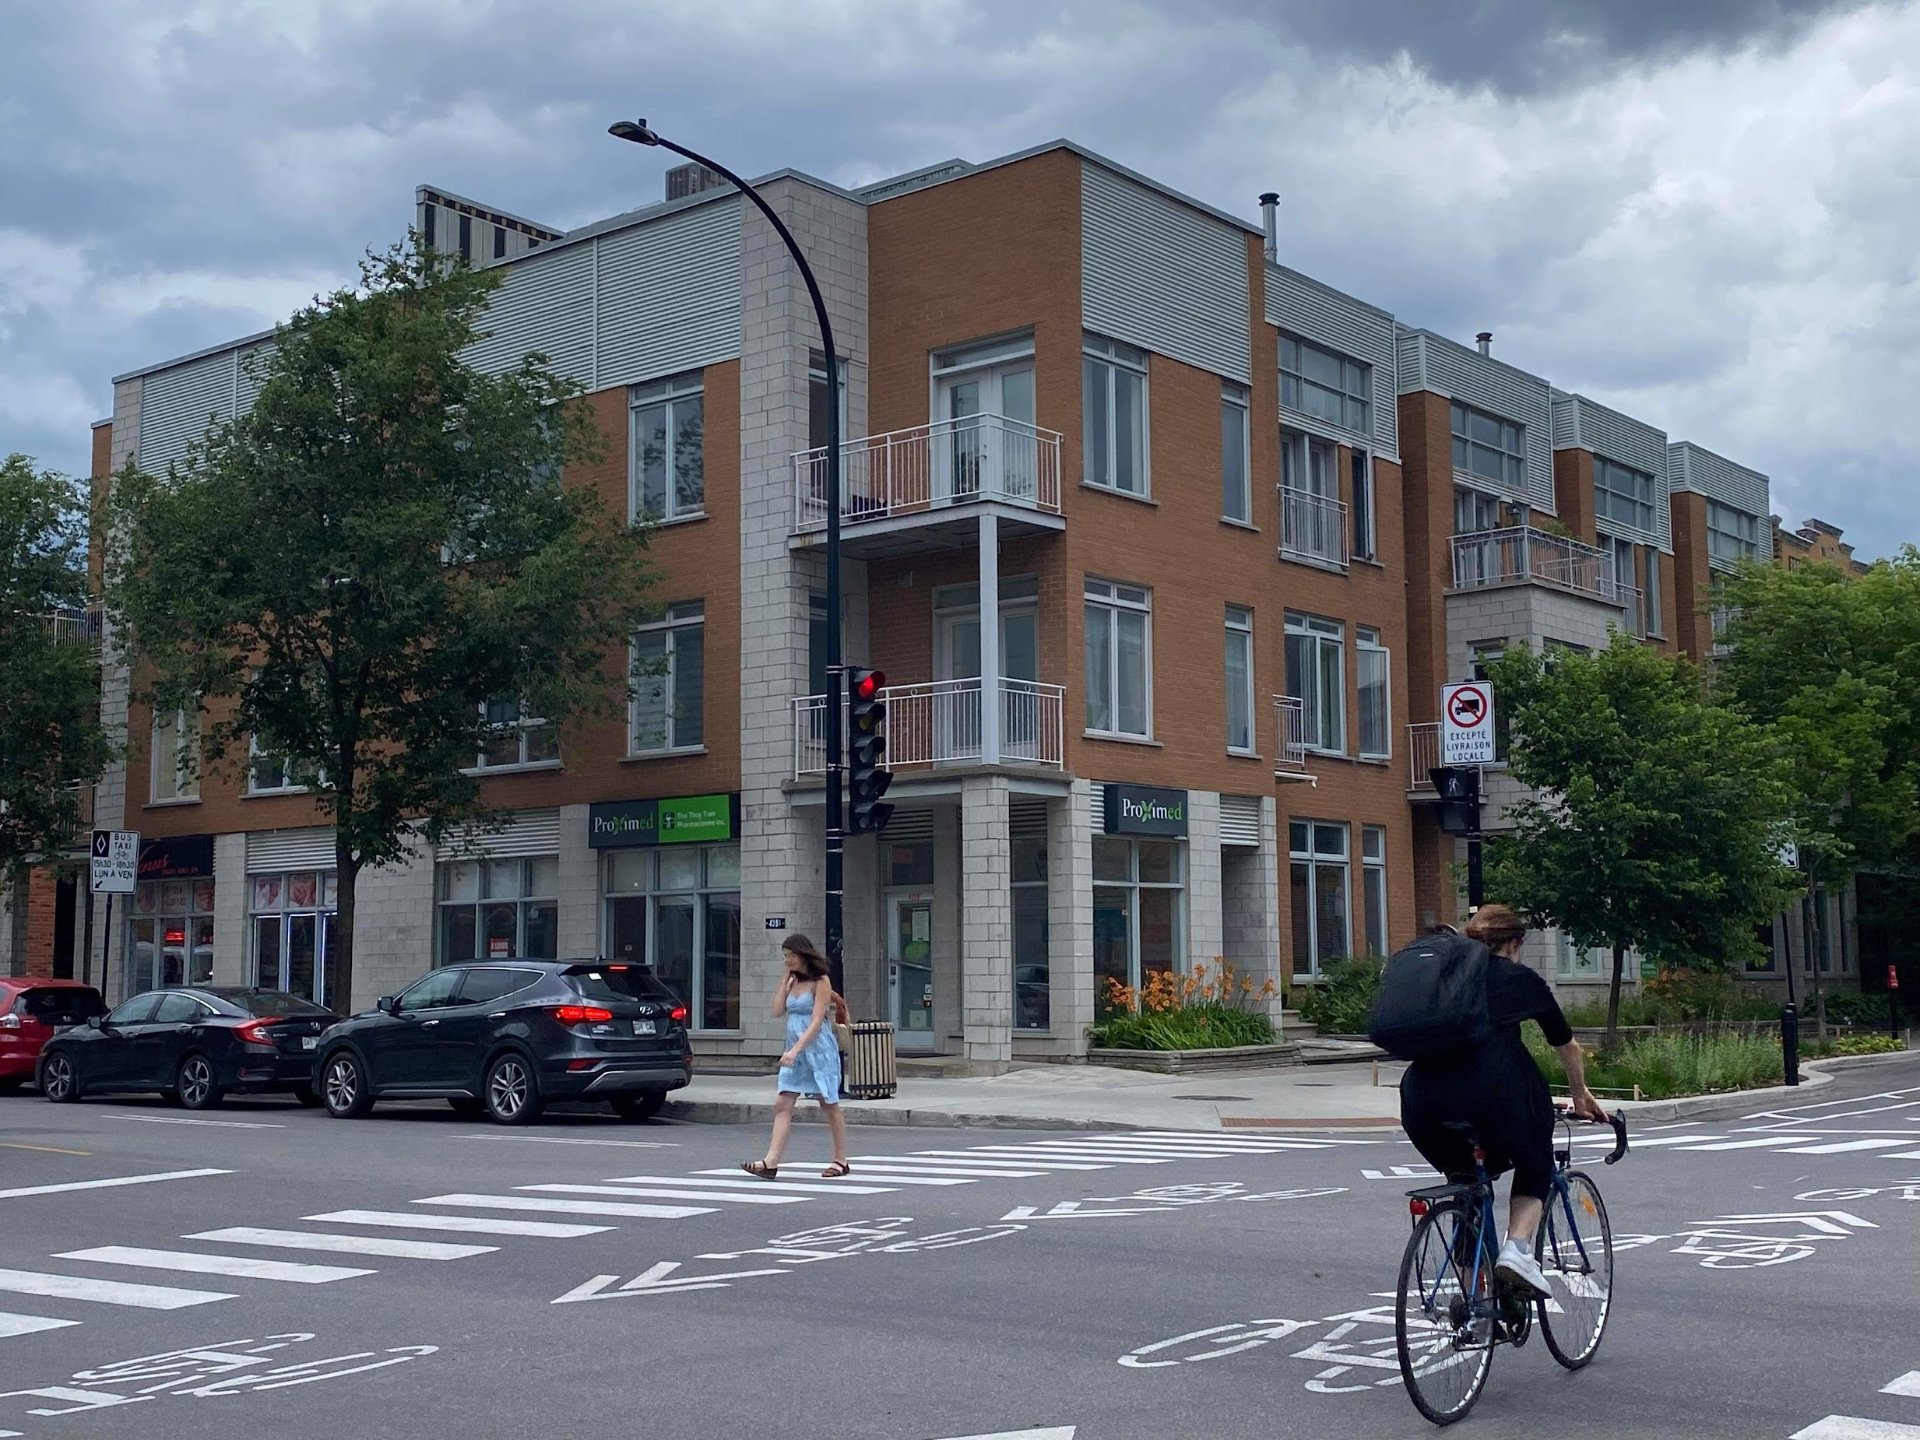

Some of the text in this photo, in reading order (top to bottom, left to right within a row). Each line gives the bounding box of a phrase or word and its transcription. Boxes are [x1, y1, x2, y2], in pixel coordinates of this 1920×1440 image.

[1450, 729, 1486, 741] EXCEPTÉ
[1446, 741, 1491, 751] LIVRAISON
[1452, 752, 1485, 761] LOCALE
[114, 833, 132, 841] BUS
[114, 842, 131, 850] TAXI
[94, 870, 108, 878] LUN
[118, 870, 133, 879] VEN
